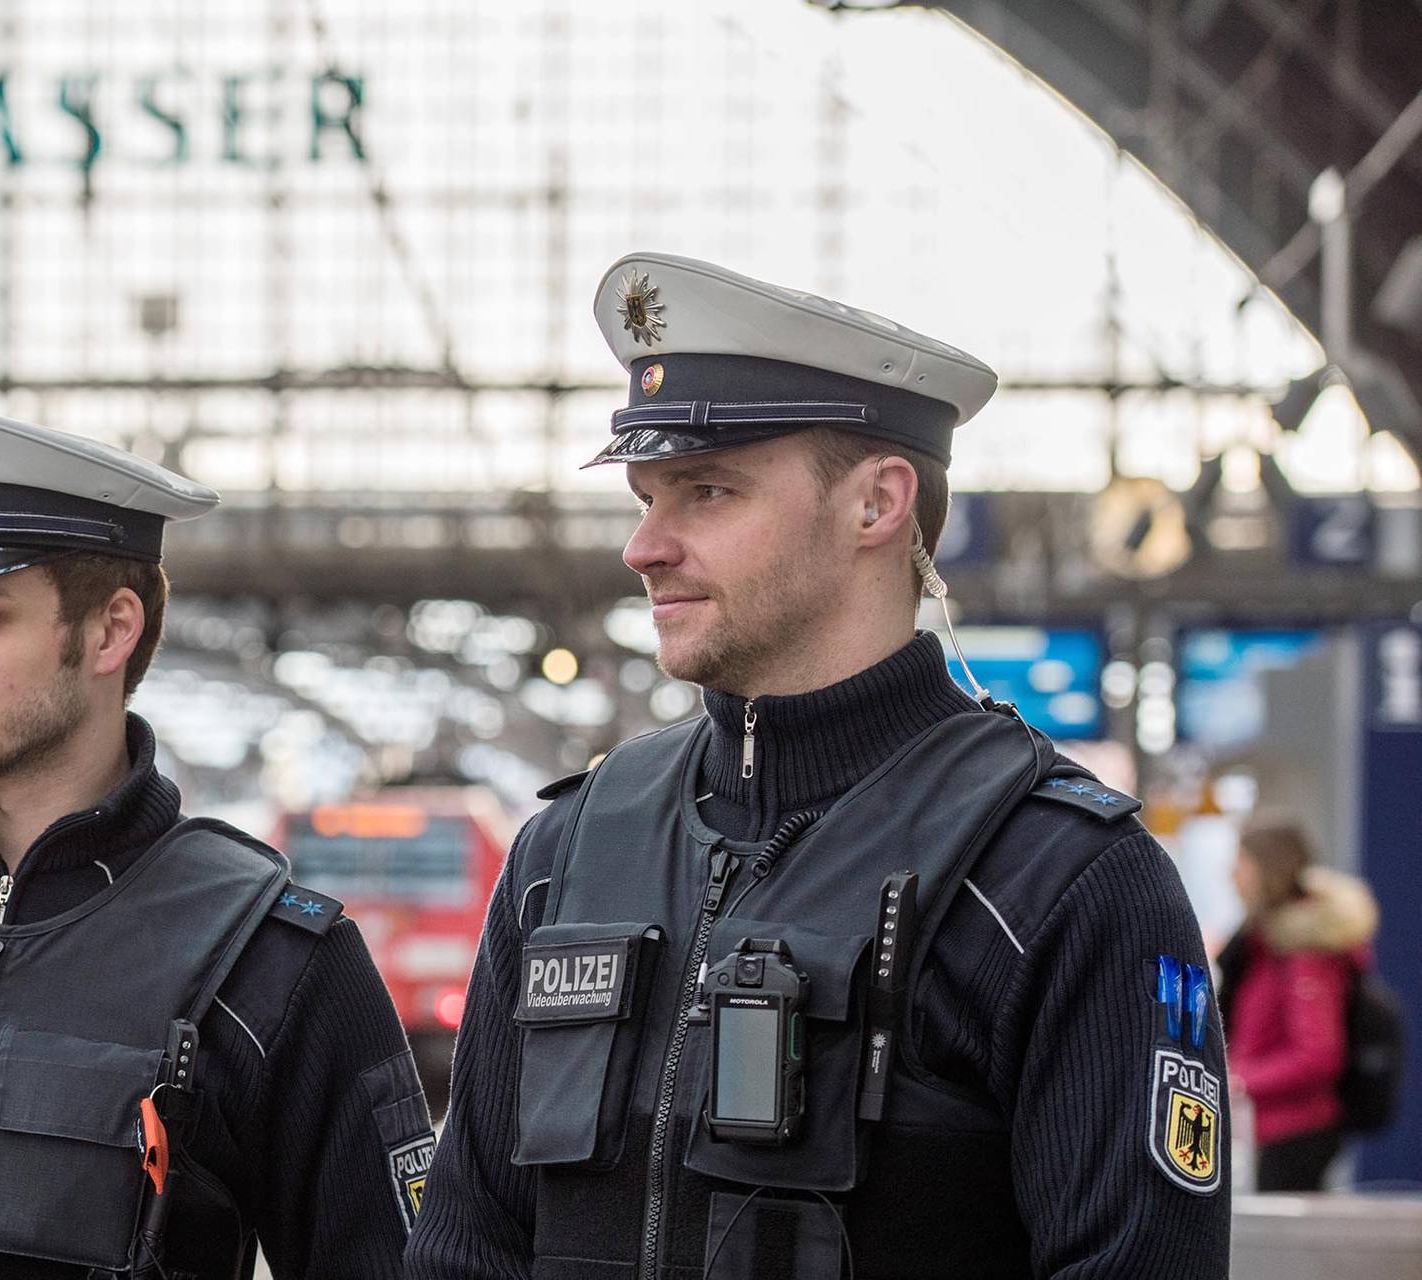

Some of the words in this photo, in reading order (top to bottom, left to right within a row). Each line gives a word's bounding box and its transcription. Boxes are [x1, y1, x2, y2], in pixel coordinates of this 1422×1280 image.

[527, 954, 618, 993] POLIZEI
[527, 990, 612, 1008] Videoüberwachung
[729, 998, 768, 1006] MOTOROLA
[1163, 1060, 1217, 1104] POLIZEI
